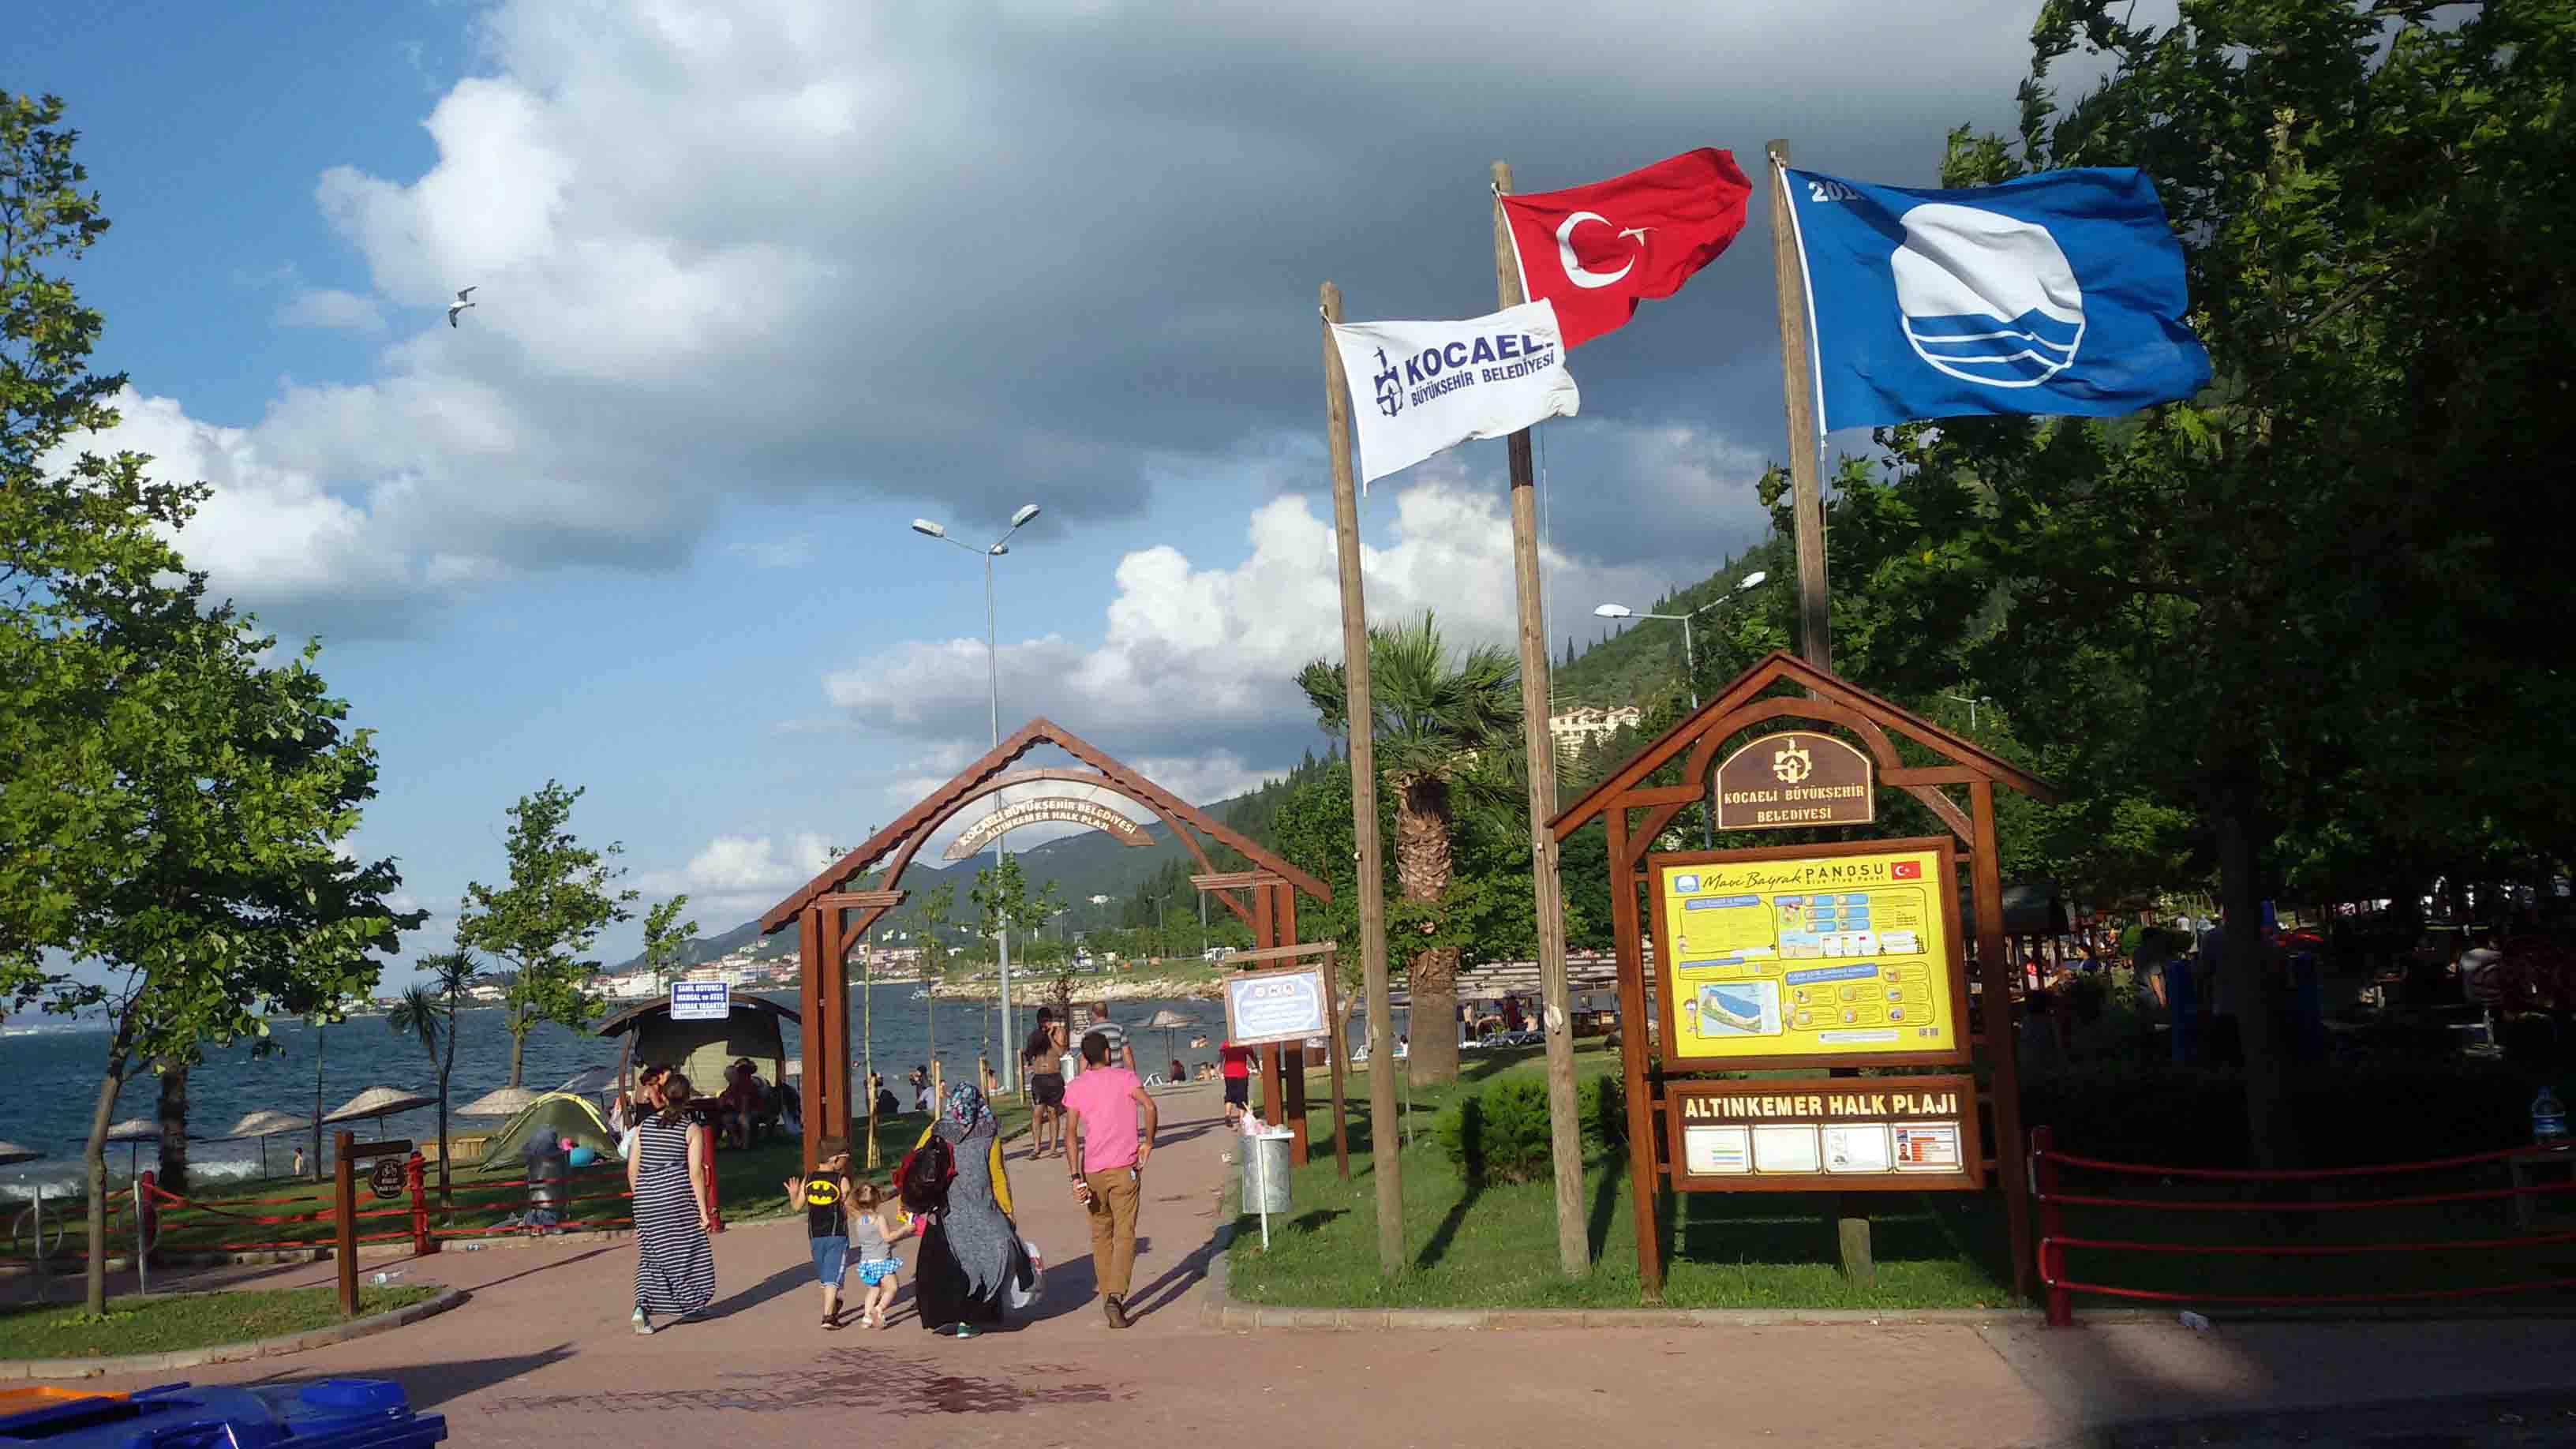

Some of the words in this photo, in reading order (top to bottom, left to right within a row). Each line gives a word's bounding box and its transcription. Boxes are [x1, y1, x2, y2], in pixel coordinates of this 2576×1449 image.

[1808, 181, 1863, 202] 201
[1482, 350, 1555, 383] BELEDİYESİ
[1785, 783, 1864, 801] BÜYÜKŞEHİR
[1051, 811, 1079, 822] HALK
[1758, 805, 1832, 822] BELEDİYESİ
[1805, 863, 1885, 880] PANOSU
[1684, 1095, 1823, 1118] ALTINKEMER
[1828, 1094, 1888, 1116] HALK
[1893, 1093, 1957, 1114] PLAJI
